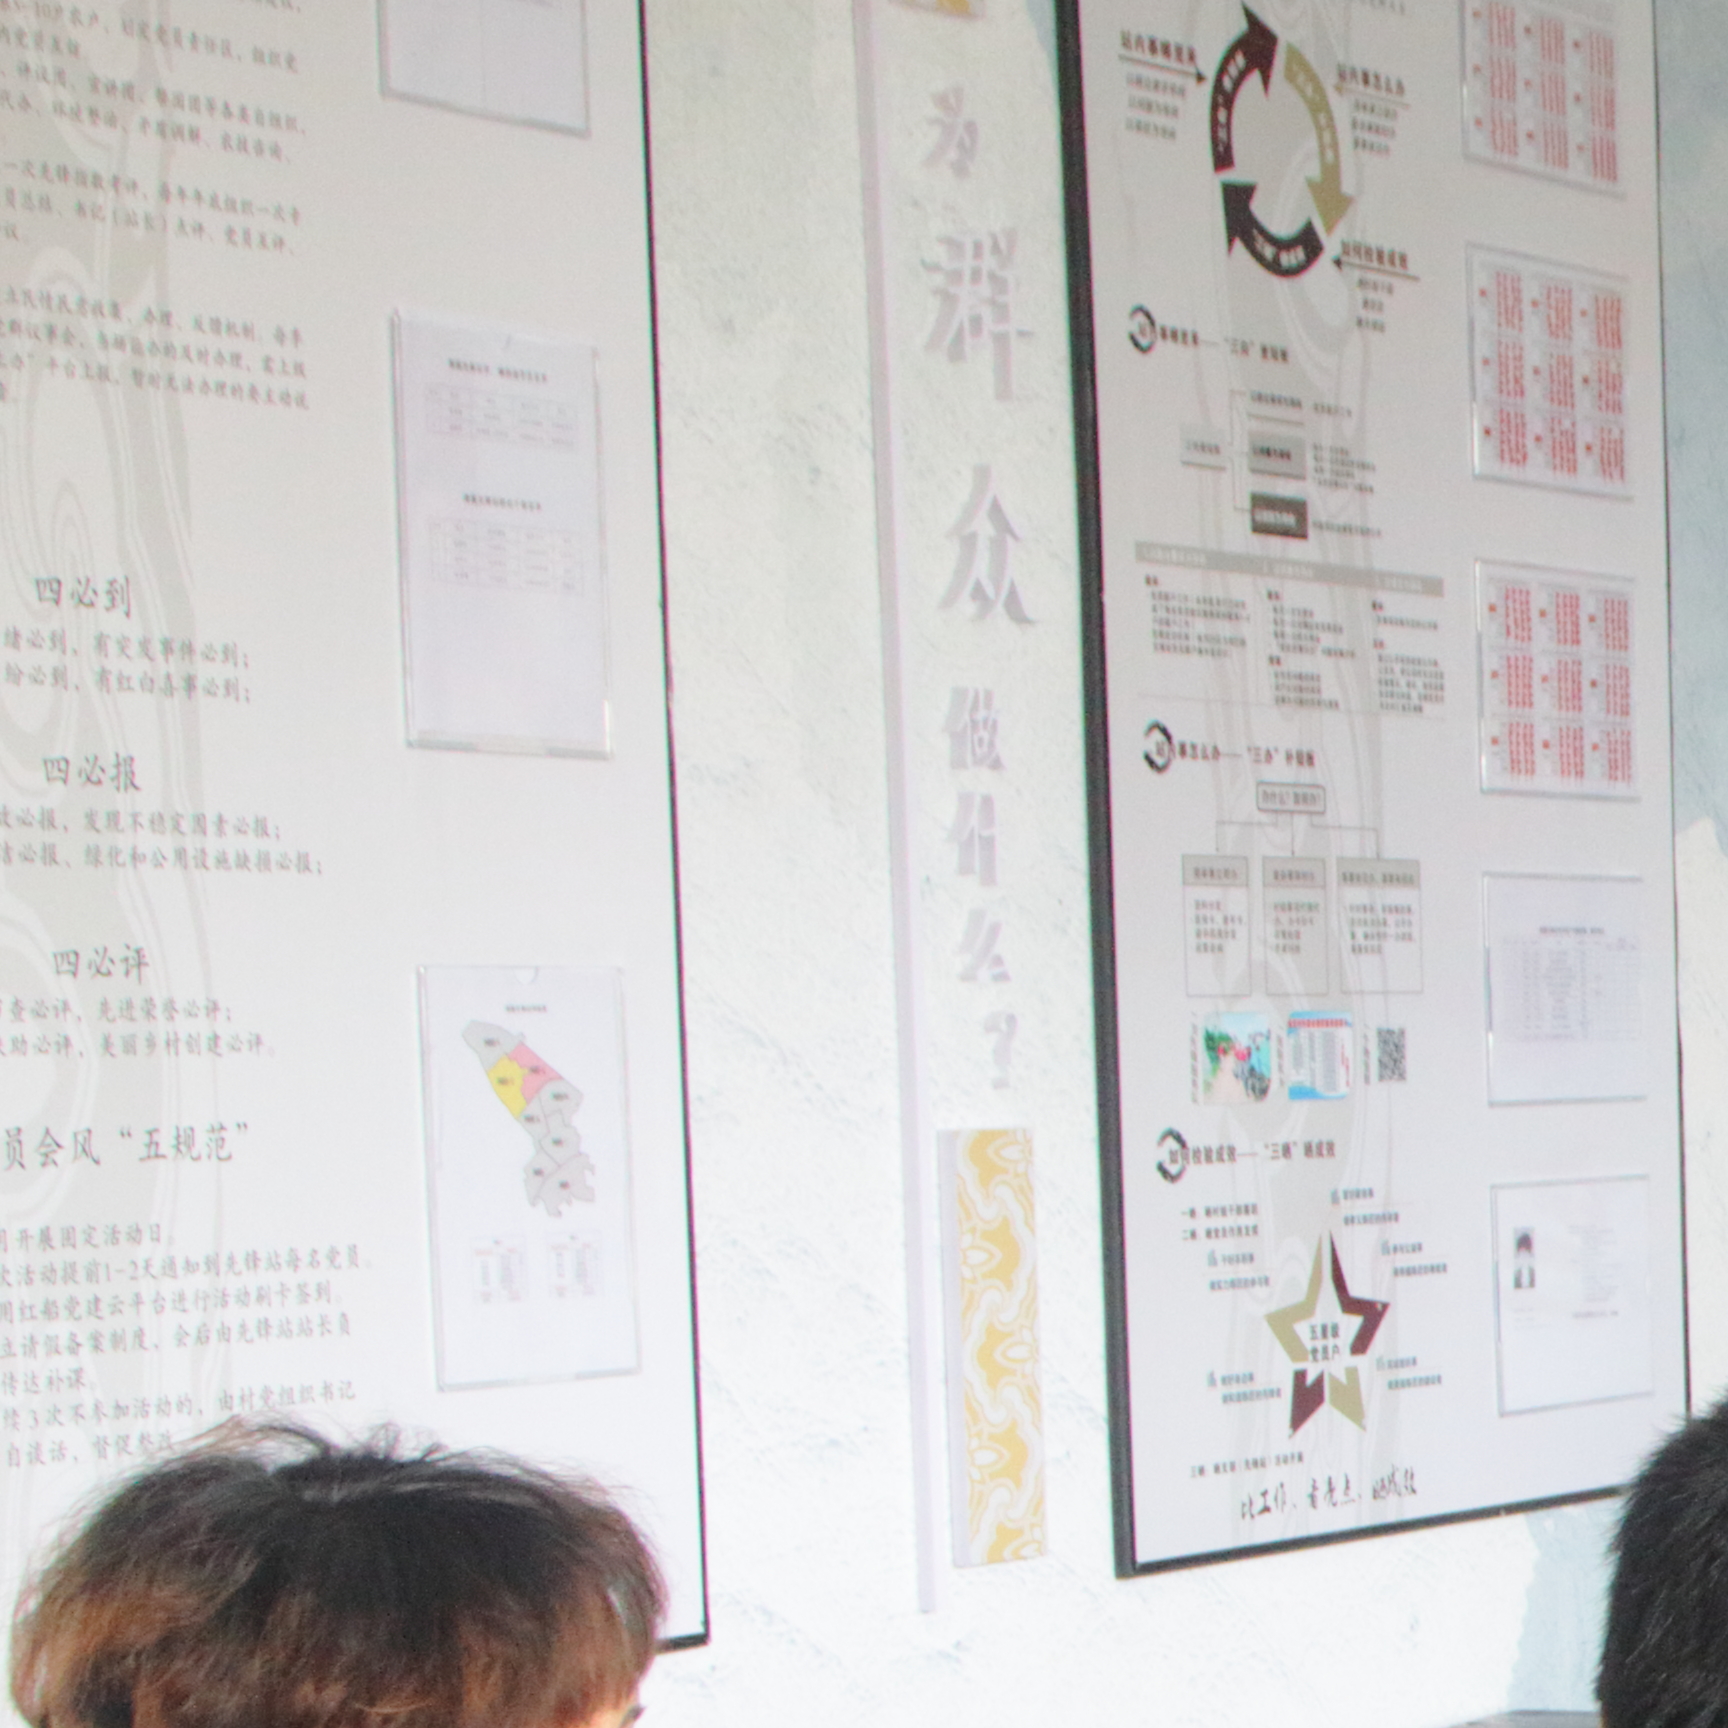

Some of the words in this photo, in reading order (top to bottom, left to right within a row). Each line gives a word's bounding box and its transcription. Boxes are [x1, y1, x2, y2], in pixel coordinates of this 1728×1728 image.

[34, 575, 132, 620] 四必到
[42, 751, 142, 794] 四必报
[52, 942, 150, 985] 四必评
